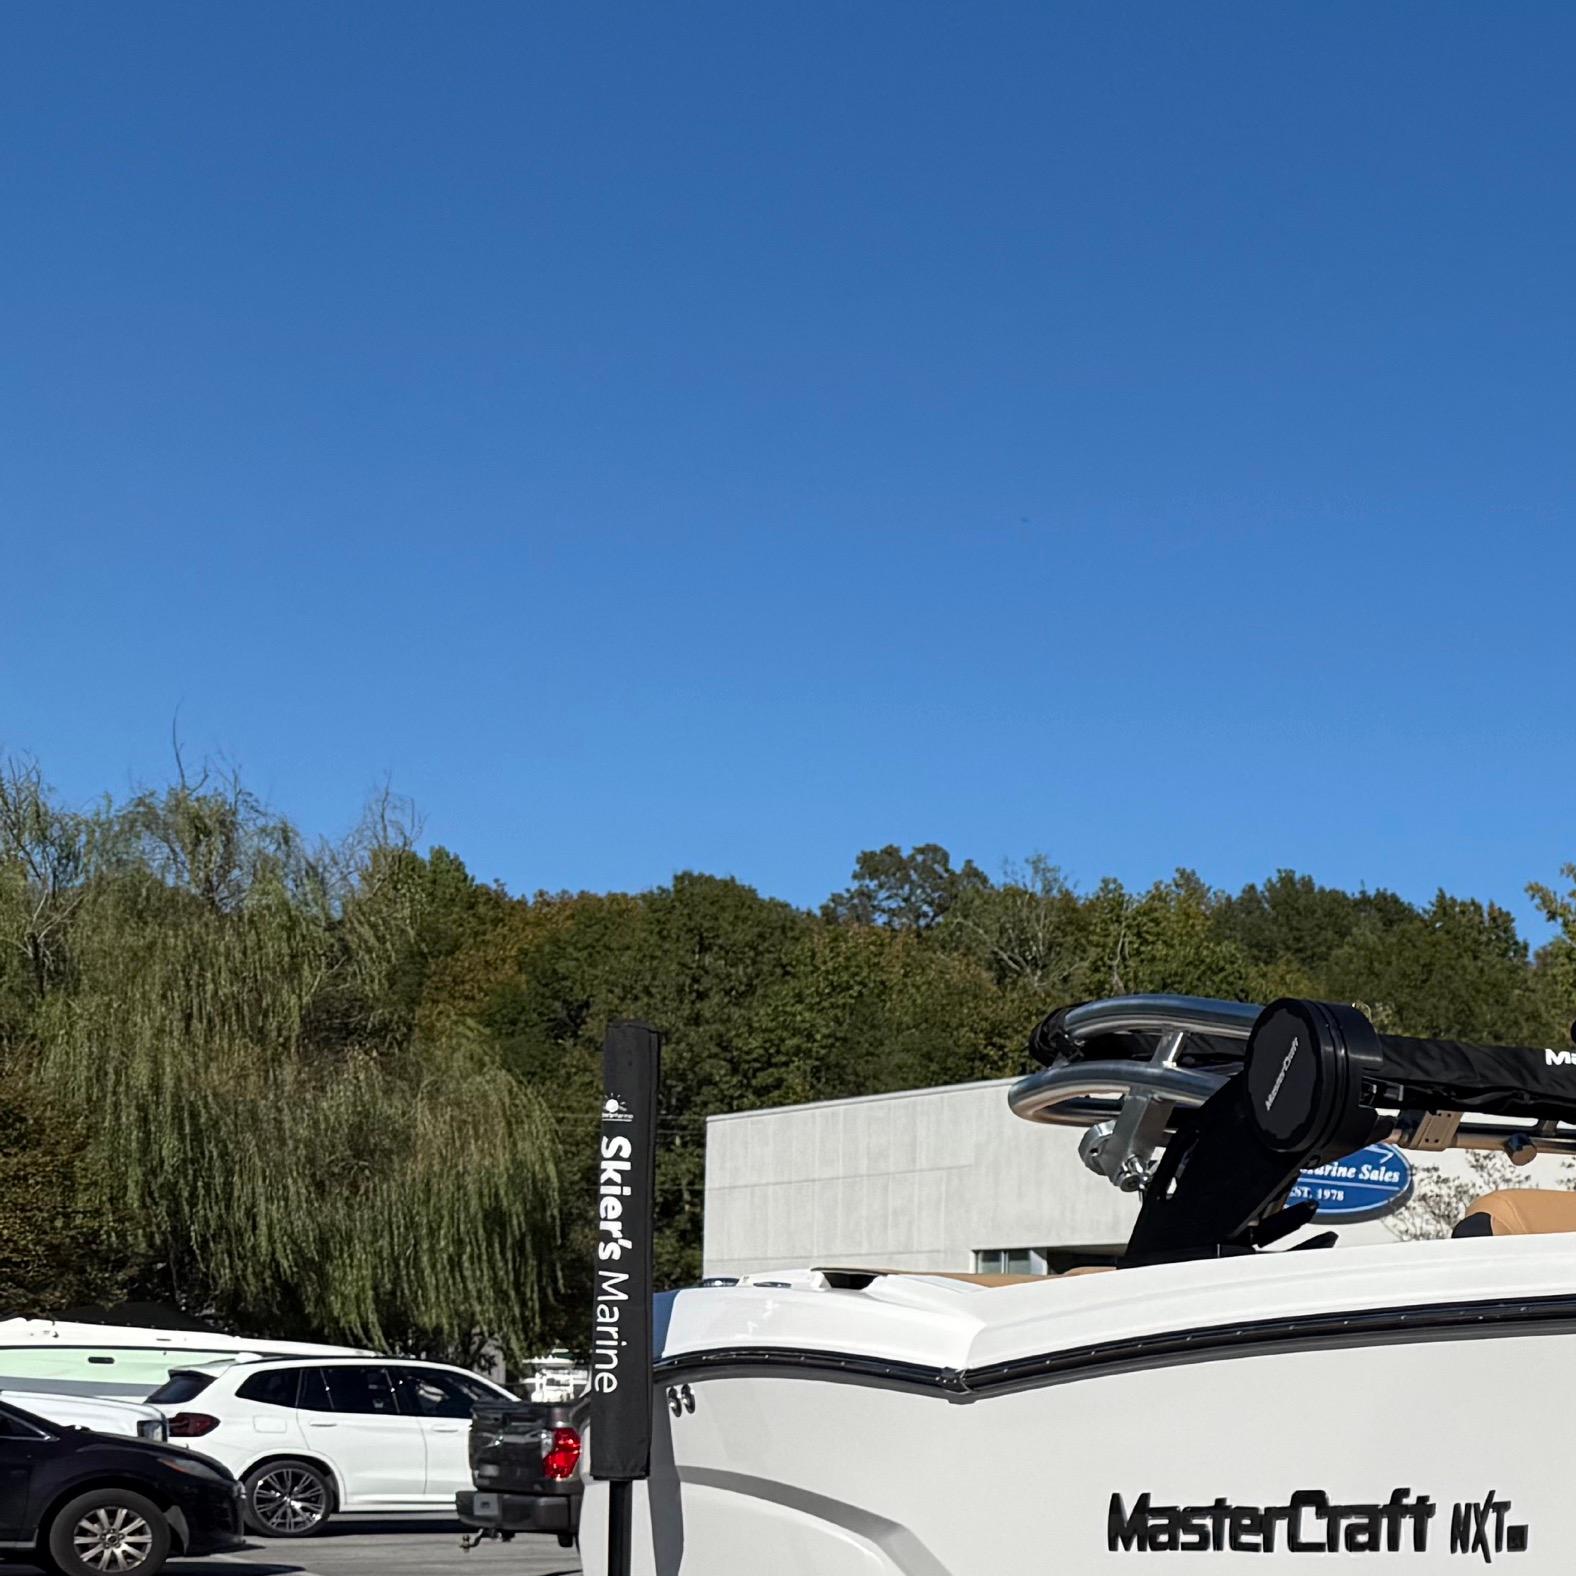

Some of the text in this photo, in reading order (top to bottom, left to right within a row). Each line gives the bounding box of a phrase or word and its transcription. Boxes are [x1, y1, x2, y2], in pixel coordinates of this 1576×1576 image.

[599, 1135, 633, 1260] Skier's
[1300, 1162, 1400, 1182] arine Sales
[1317, 1188, 1344, 1201] 1978
[595, 1270, 629, 1393] Marine
[1108, 1488, 1511, 1563] MasterCraft NXT
